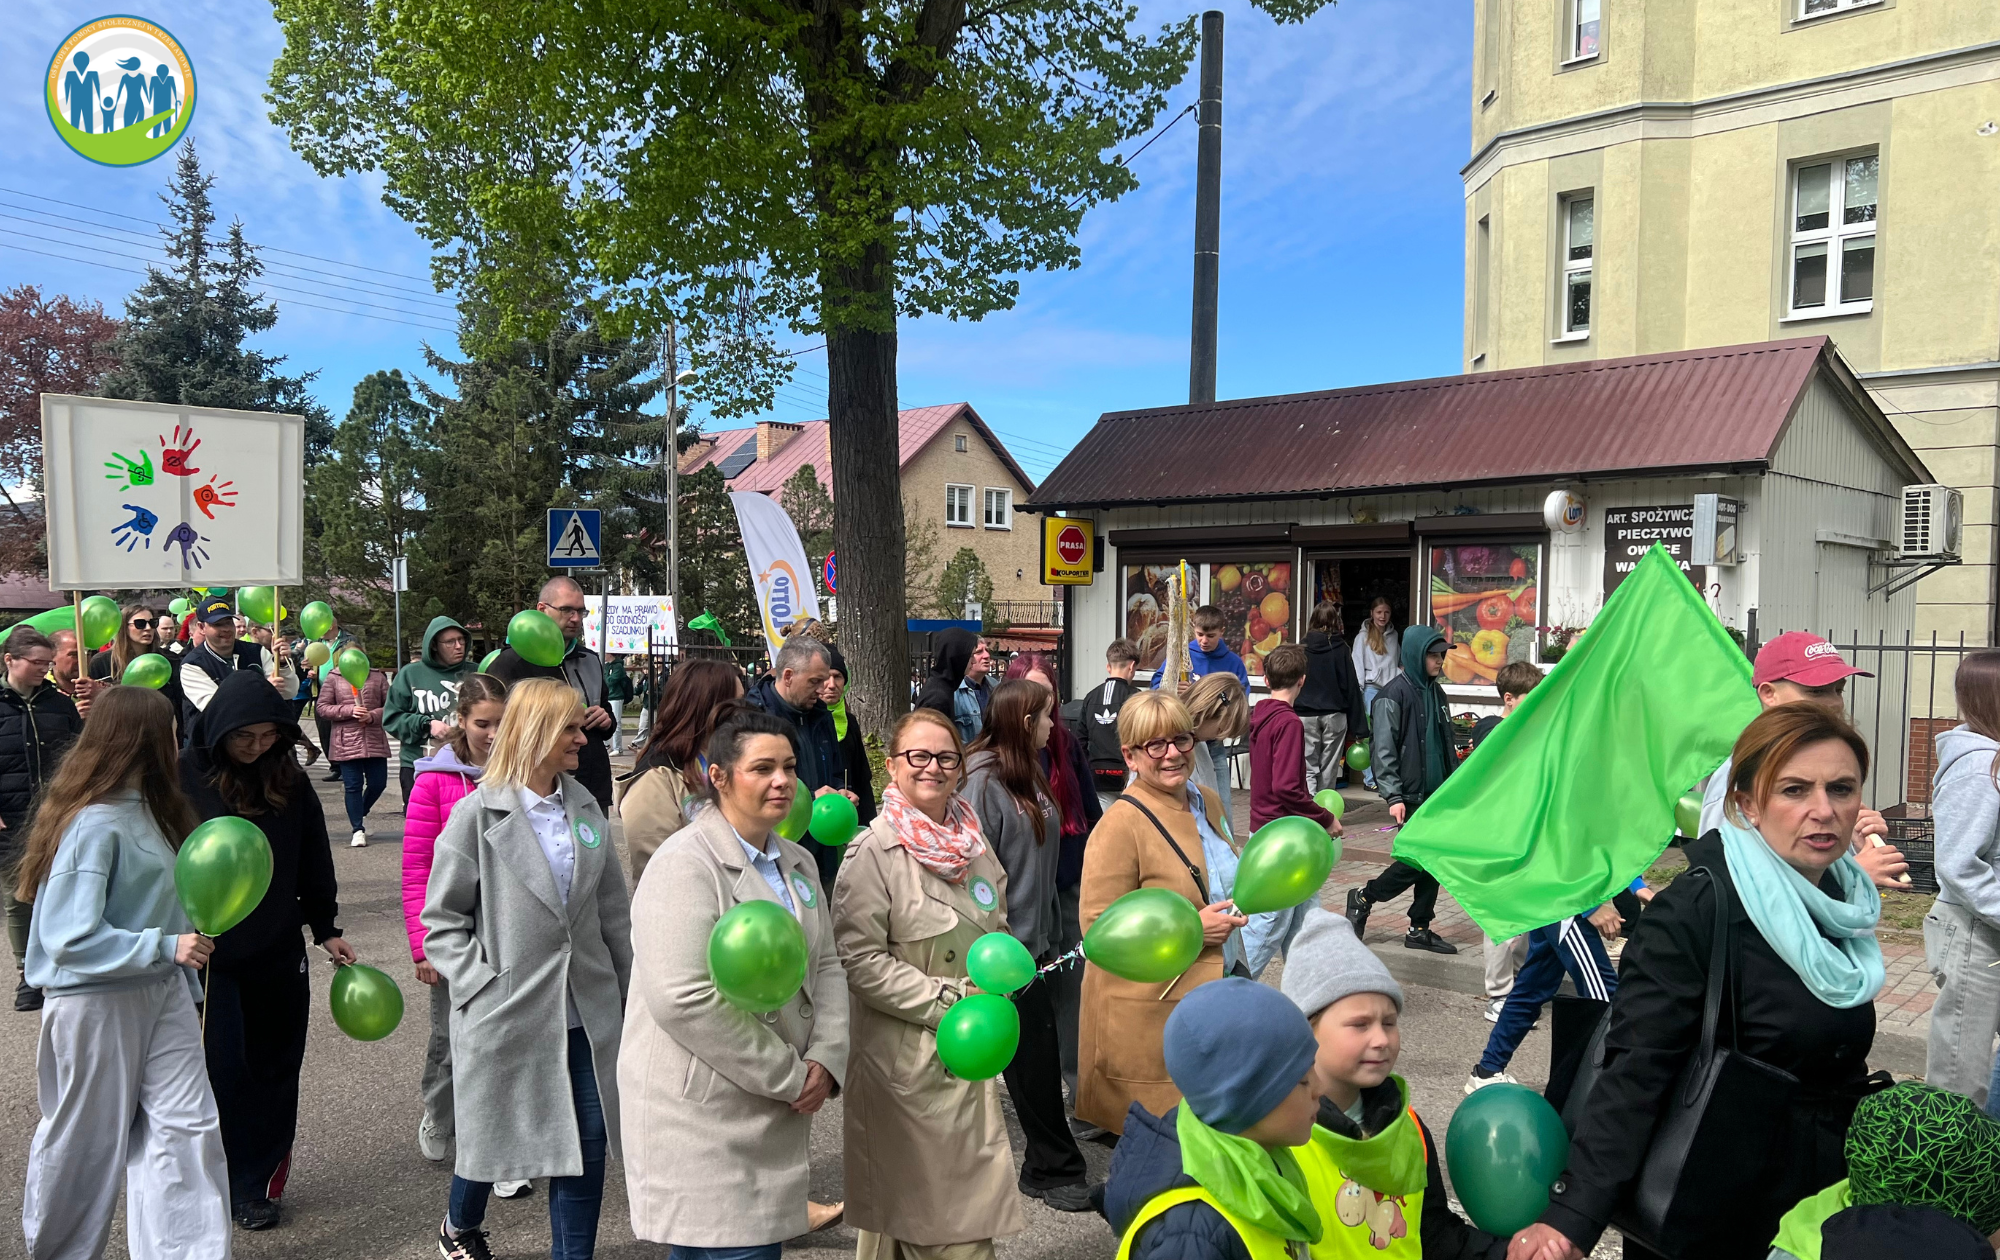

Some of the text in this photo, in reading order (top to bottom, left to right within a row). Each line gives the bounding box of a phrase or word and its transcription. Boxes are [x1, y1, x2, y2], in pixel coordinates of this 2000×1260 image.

[1607, 506, 1695, 524] ART. SPOŻYWCZ
[1618, 527, 1693, 540] PIECZYWO
[1060, 541, 1084, 550] PRASA
[1627, 544, 1681, 556] OWCE
[1056, 569, 1090, 578] KOLPORTER
[621, 605, 633, 614] MA
[634, 604, 658, 614] PRAWO
[606, 613, 648, 625] DO GODNOŚCI
[413, 689, 451, 714] The
